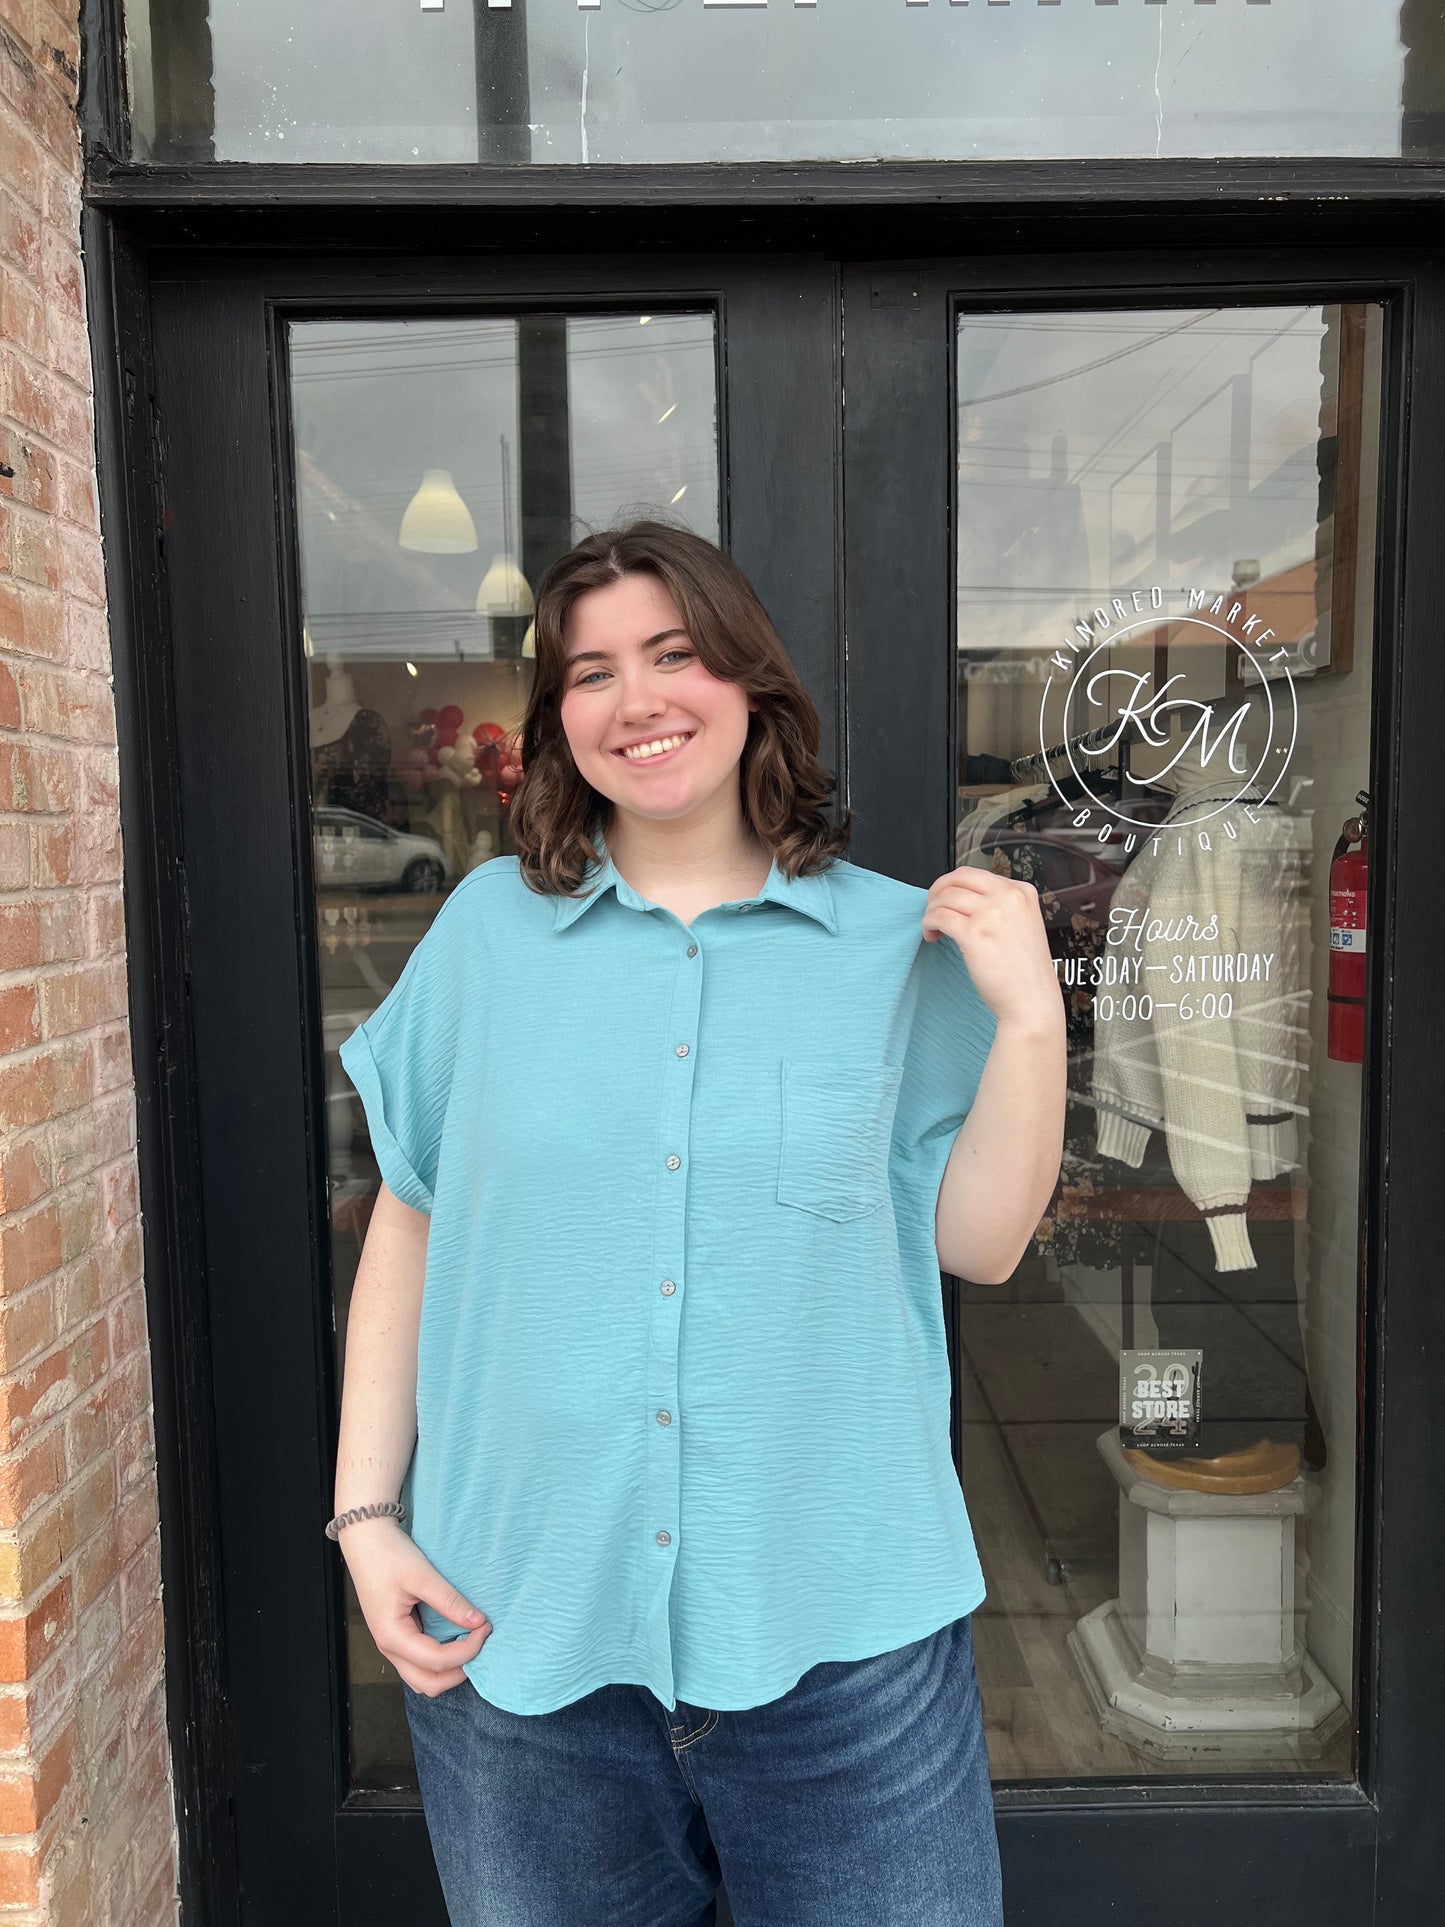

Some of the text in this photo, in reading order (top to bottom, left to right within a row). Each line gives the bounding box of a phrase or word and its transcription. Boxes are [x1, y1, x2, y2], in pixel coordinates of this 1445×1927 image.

[1050, 586, 1289, 671] KINDRED MARKET
[1079, 669, 1252, 785] KM
[1072, 804, 1262, 857] BOUTIQUE
[1106, 907, 1219, 952] Hours
[1131, 1400, 1191, 1419] STORE
[1136, 1380, 1184, 1398] BEST
